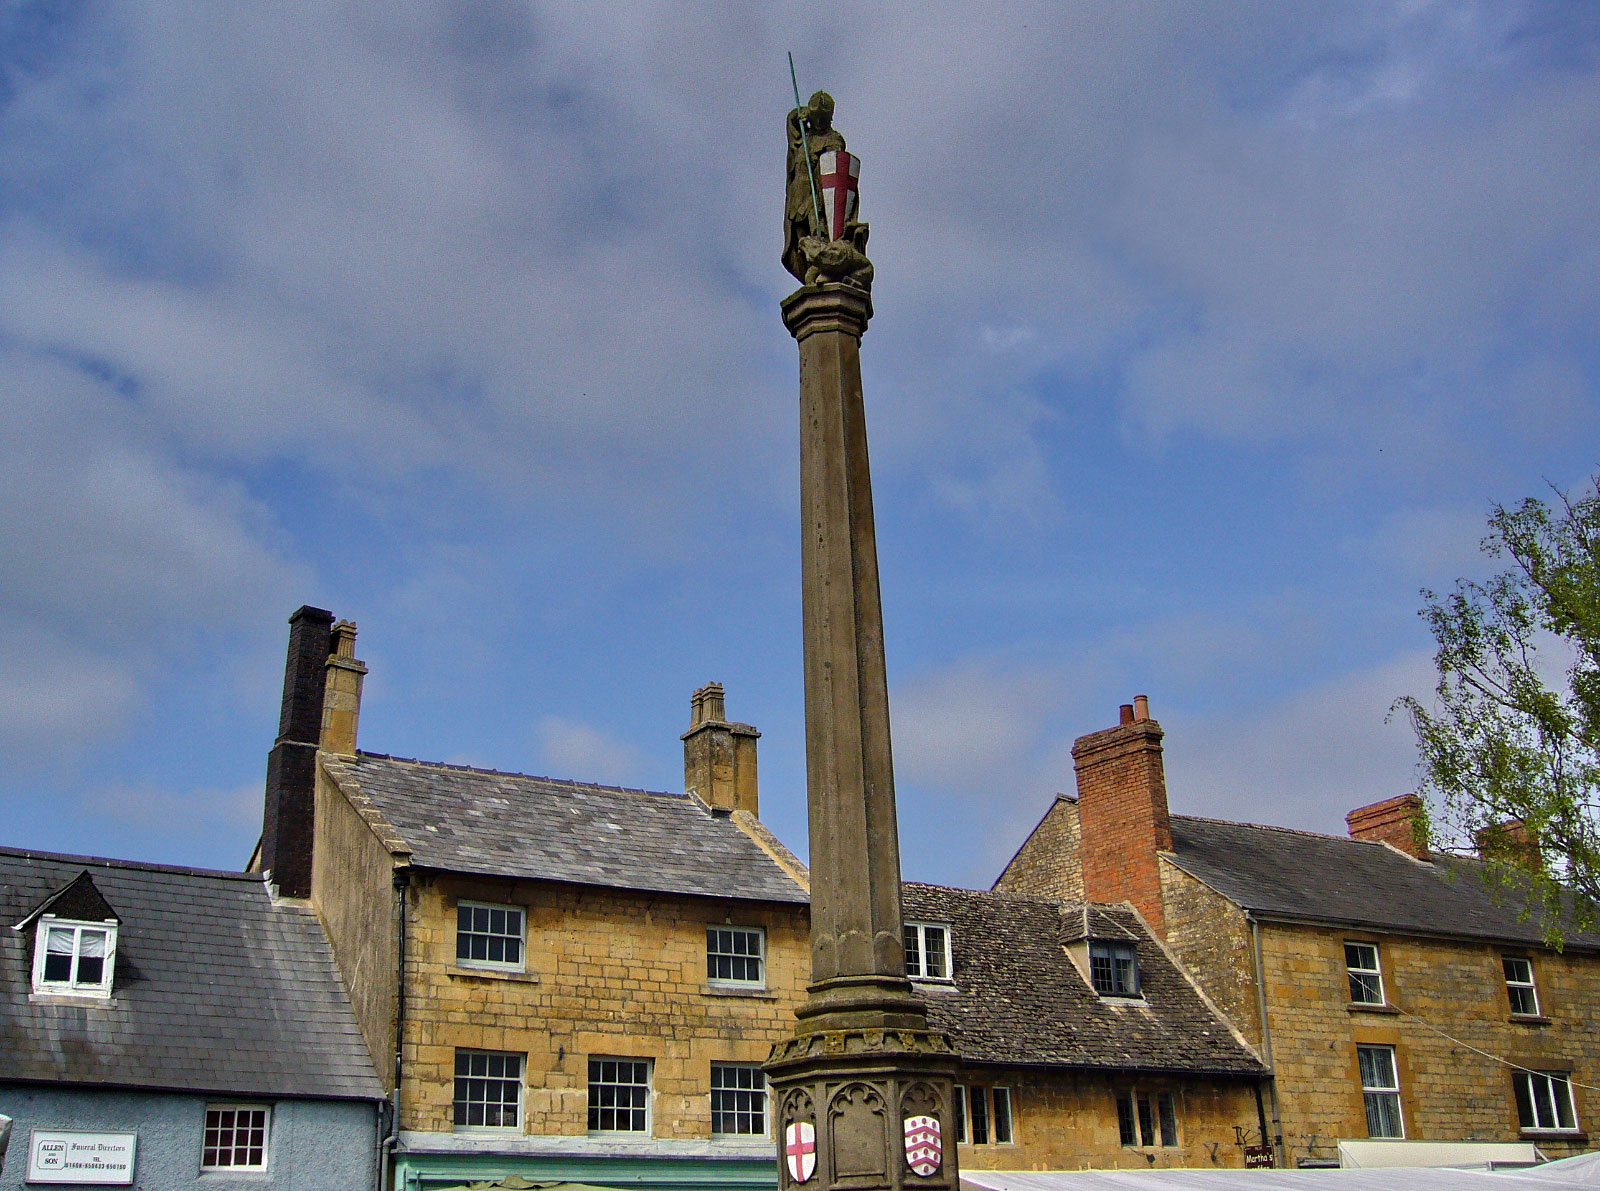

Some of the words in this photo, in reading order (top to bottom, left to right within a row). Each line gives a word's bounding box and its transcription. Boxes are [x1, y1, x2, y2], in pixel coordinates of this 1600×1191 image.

[42, 1144, 64, 1152] ALLEN
[71, 1142, 96, 1151] Funeral
[98, 1143, 126, 1152] Directors
[1246, 1152, 1273, 1164] Martha's
